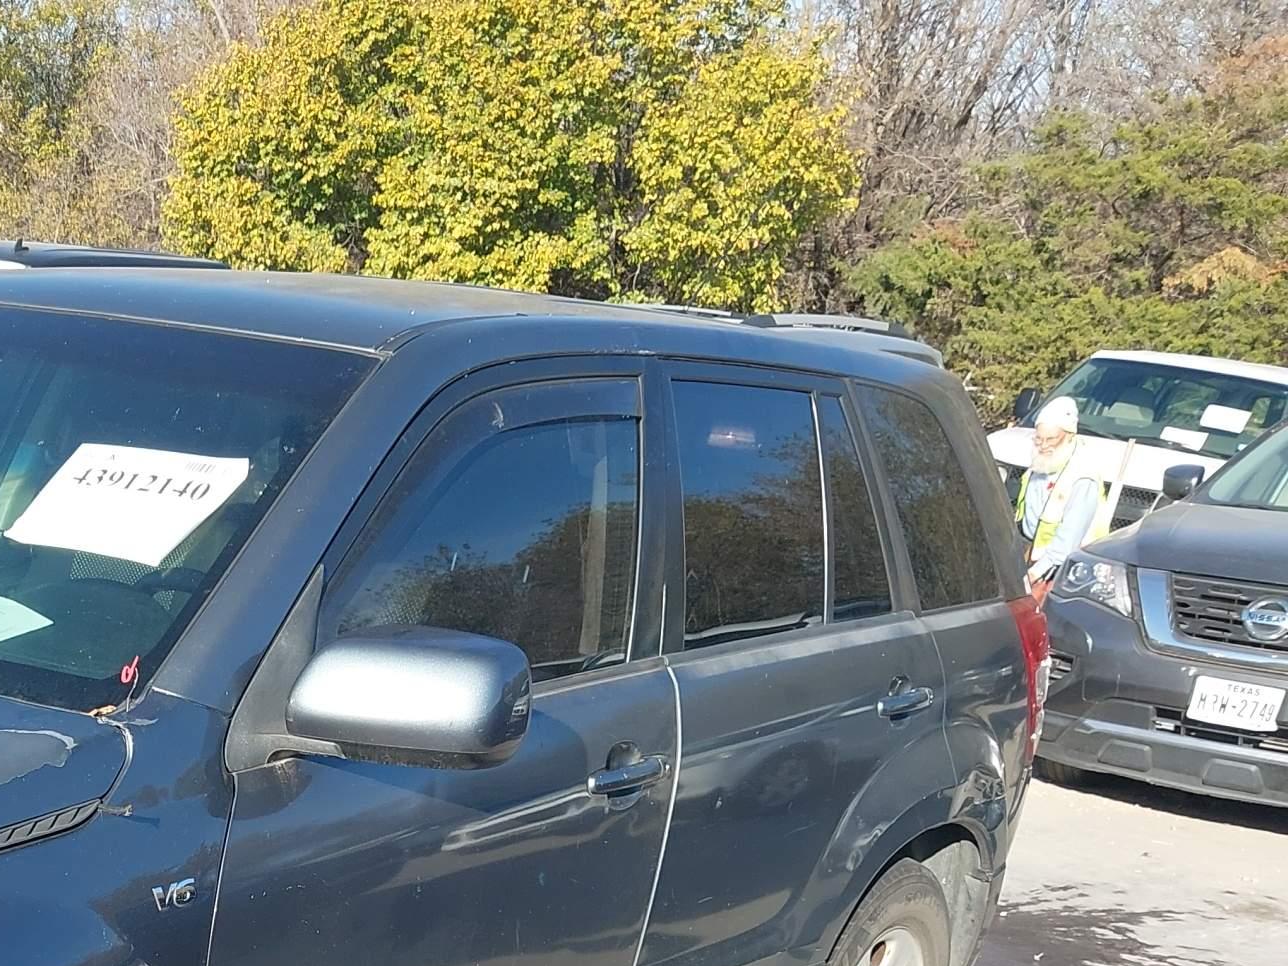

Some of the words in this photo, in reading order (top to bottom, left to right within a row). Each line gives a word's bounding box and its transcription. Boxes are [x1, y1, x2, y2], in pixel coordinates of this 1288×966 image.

[72, 467, 211, 501] 43912140
[1227, 683, 1261, 696] TEXAS
[152, 878, 196, 911] V6
